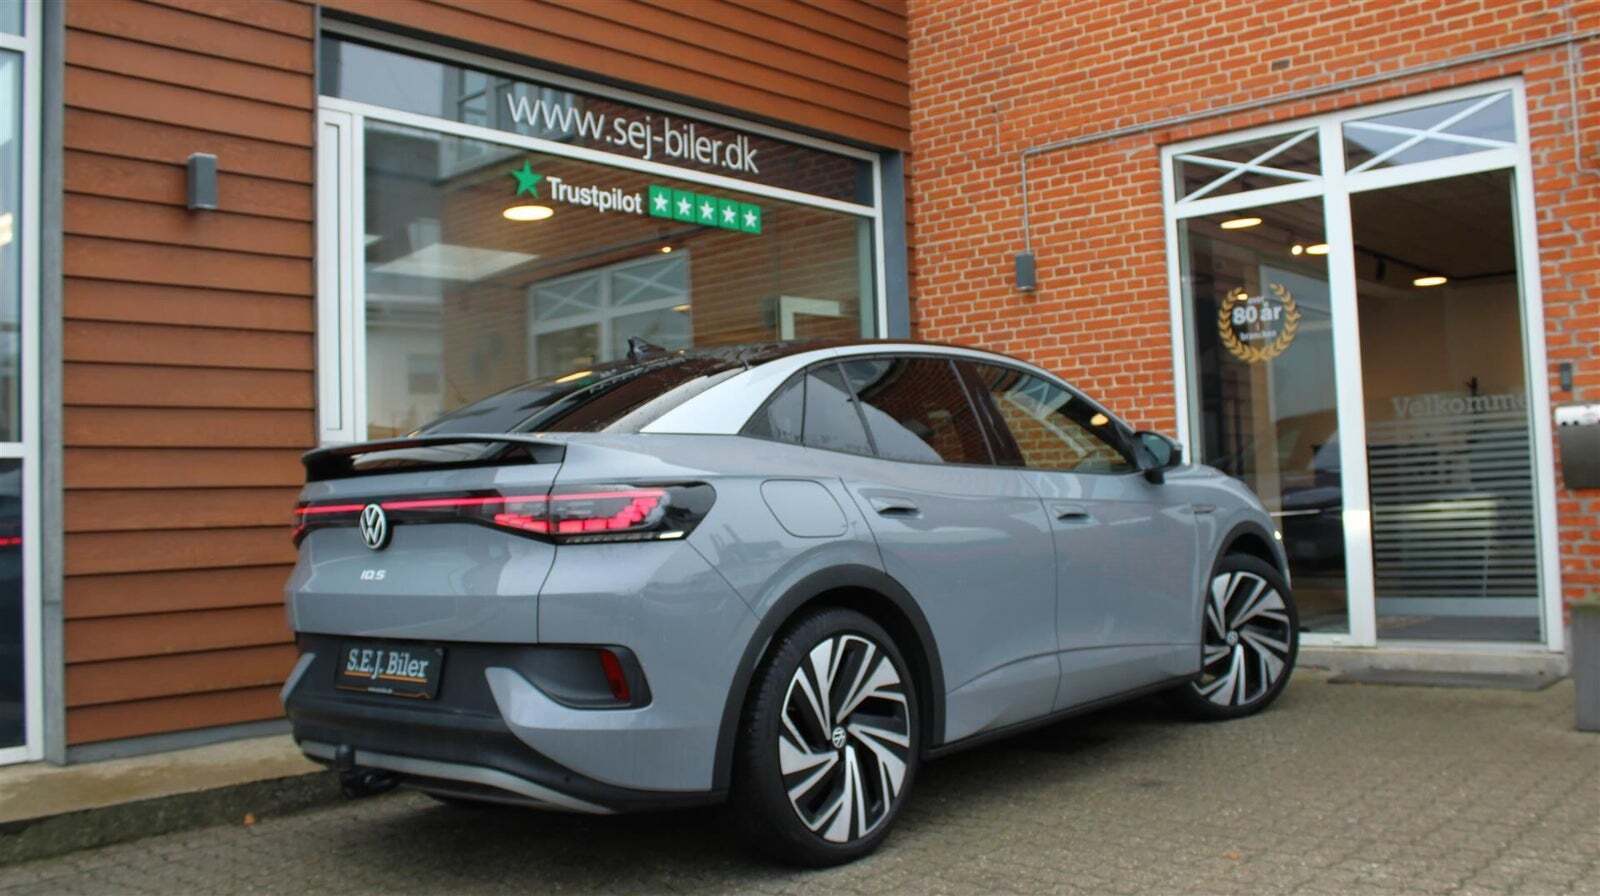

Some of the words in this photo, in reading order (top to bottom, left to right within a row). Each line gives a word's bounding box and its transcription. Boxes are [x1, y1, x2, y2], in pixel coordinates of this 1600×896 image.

[507, 92, 760, 174] www.sej-biler.dk
[546, 176, 642, 214] Trustpilot
[1232, 305, 1258, 325] 80
[1260, 302, 1283, 322] år
[346, 647, 384, 680] S.E.J.
[386, 651, 429, 678] Biler
